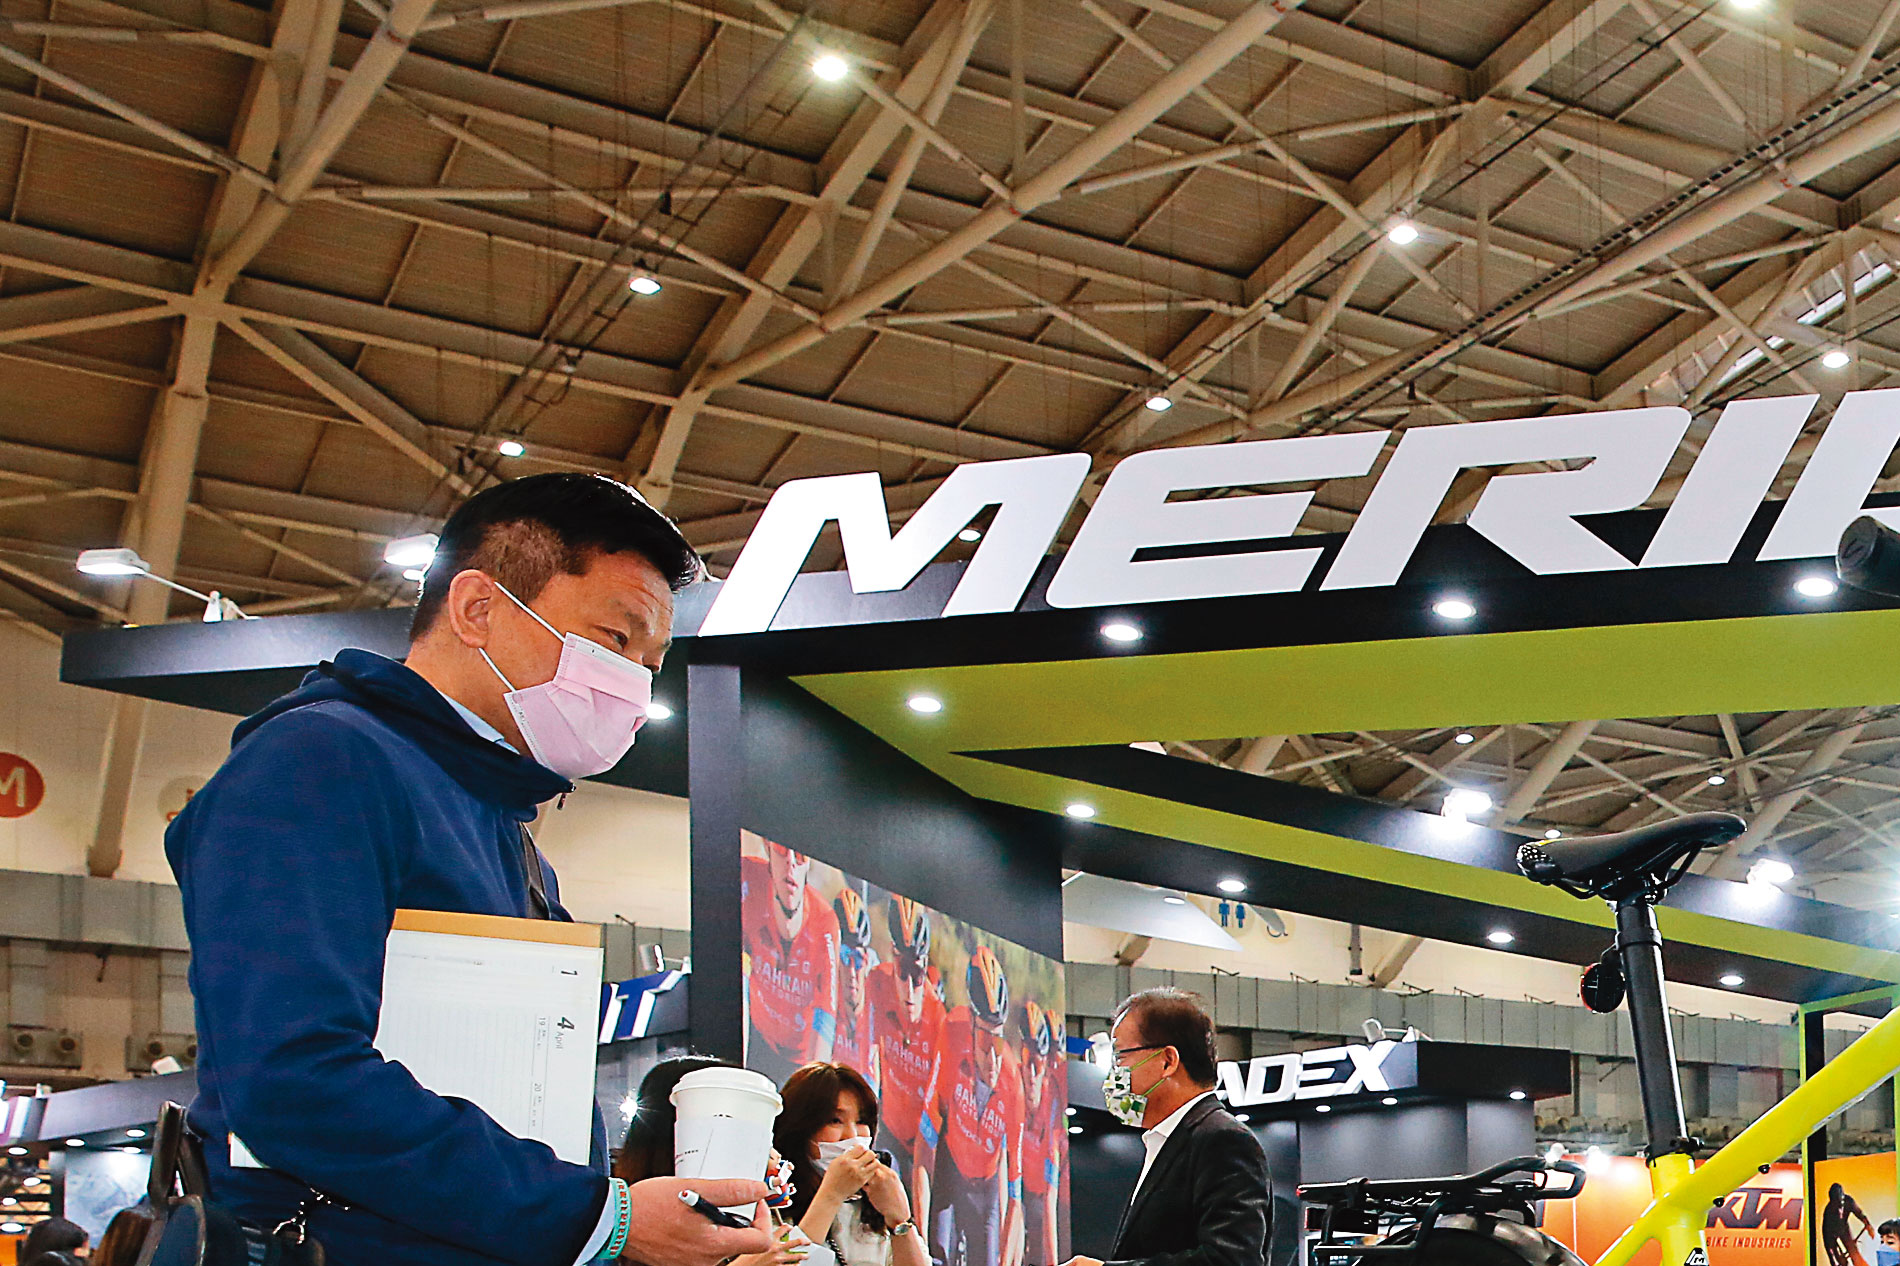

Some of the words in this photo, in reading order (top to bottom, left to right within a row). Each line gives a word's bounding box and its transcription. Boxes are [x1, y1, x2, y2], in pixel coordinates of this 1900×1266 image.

[556, 1032, 565, 1050] April
[1215, 1040, 1397, 1107] ADEX
[1705, 1188, 1804, 1230] KTM
[1706, 1236, 1728, 1248] BIKE
[1733, 1237, 1792, 1249] INDUSTRIES
